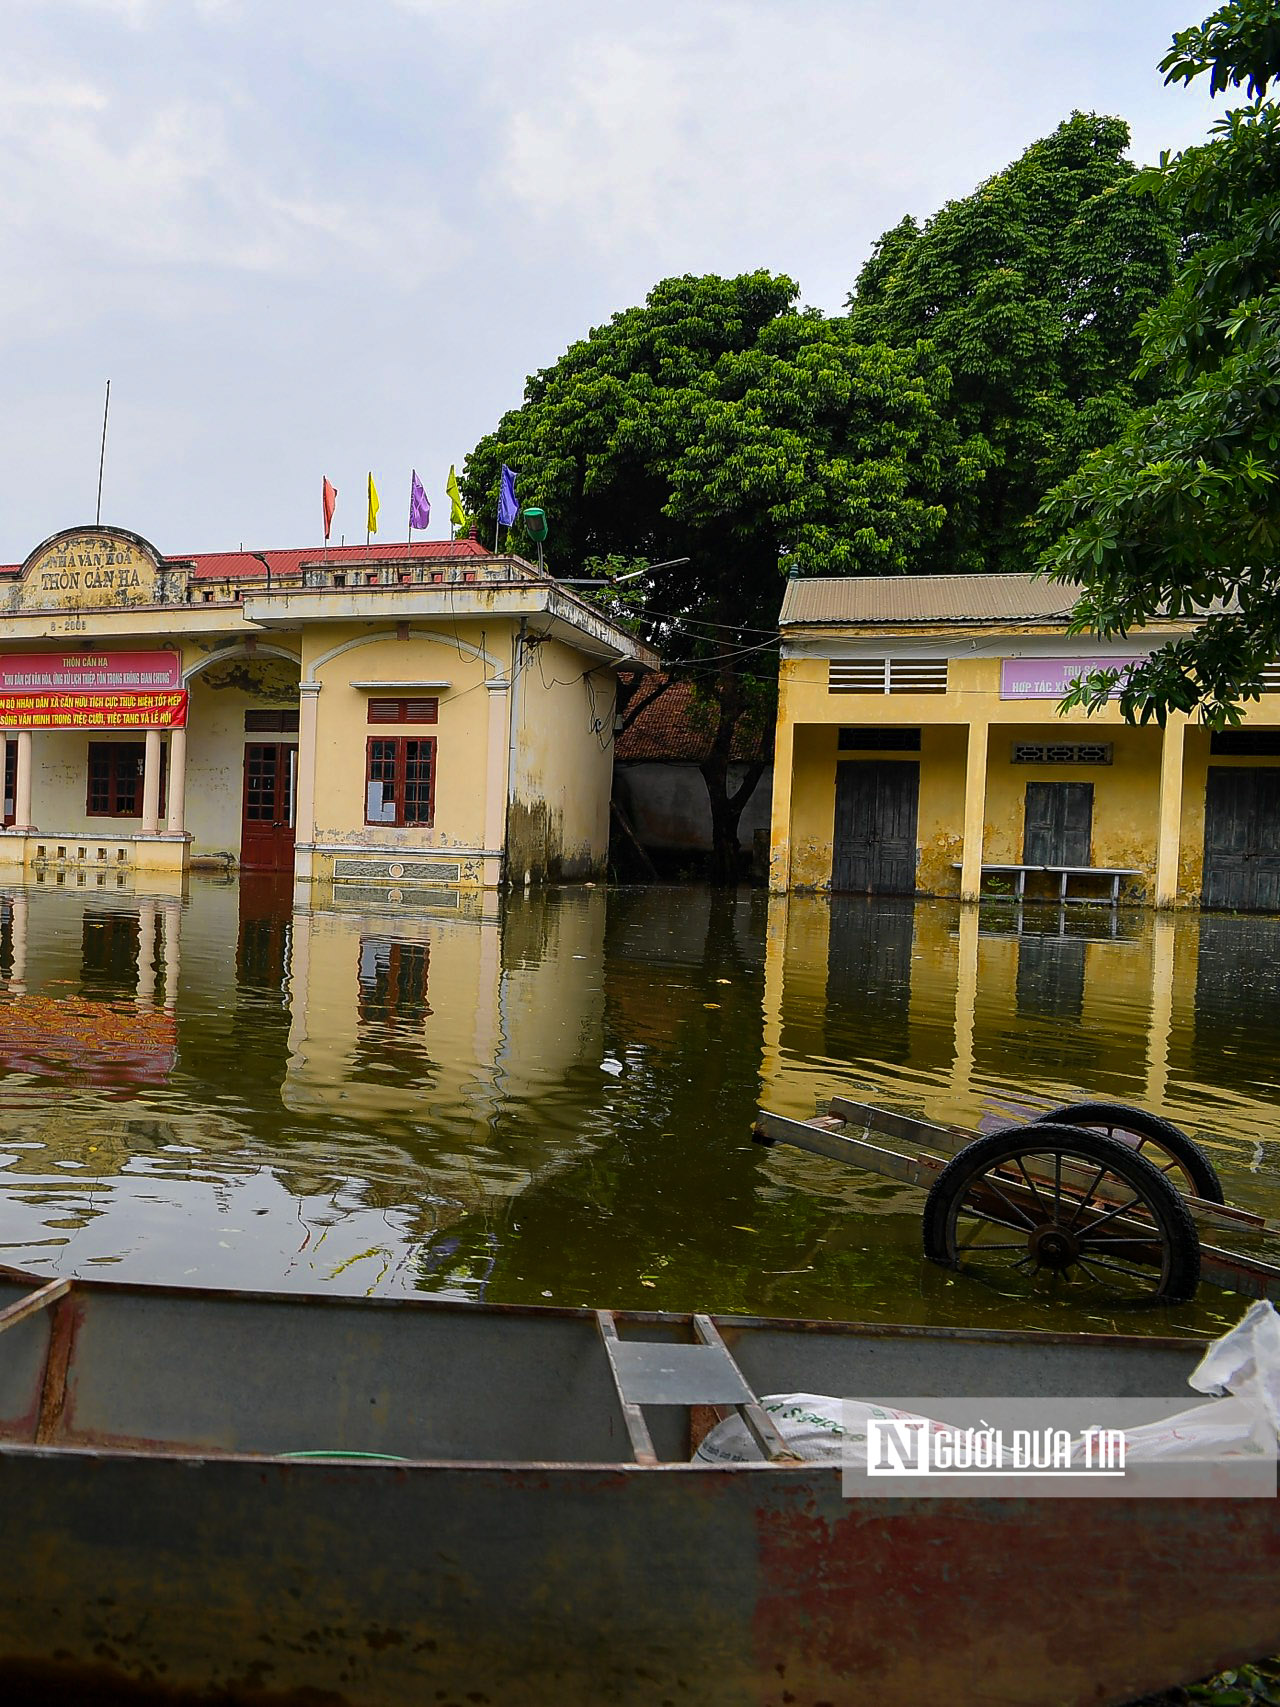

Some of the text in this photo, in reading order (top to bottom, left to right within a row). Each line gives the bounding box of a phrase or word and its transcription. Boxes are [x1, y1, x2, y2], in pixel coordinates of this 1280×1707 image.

[118, 569, 140, 590] HẠ
[63, 656, 81, 667] THÔN
[98, 657, 108, 668] HẠ
